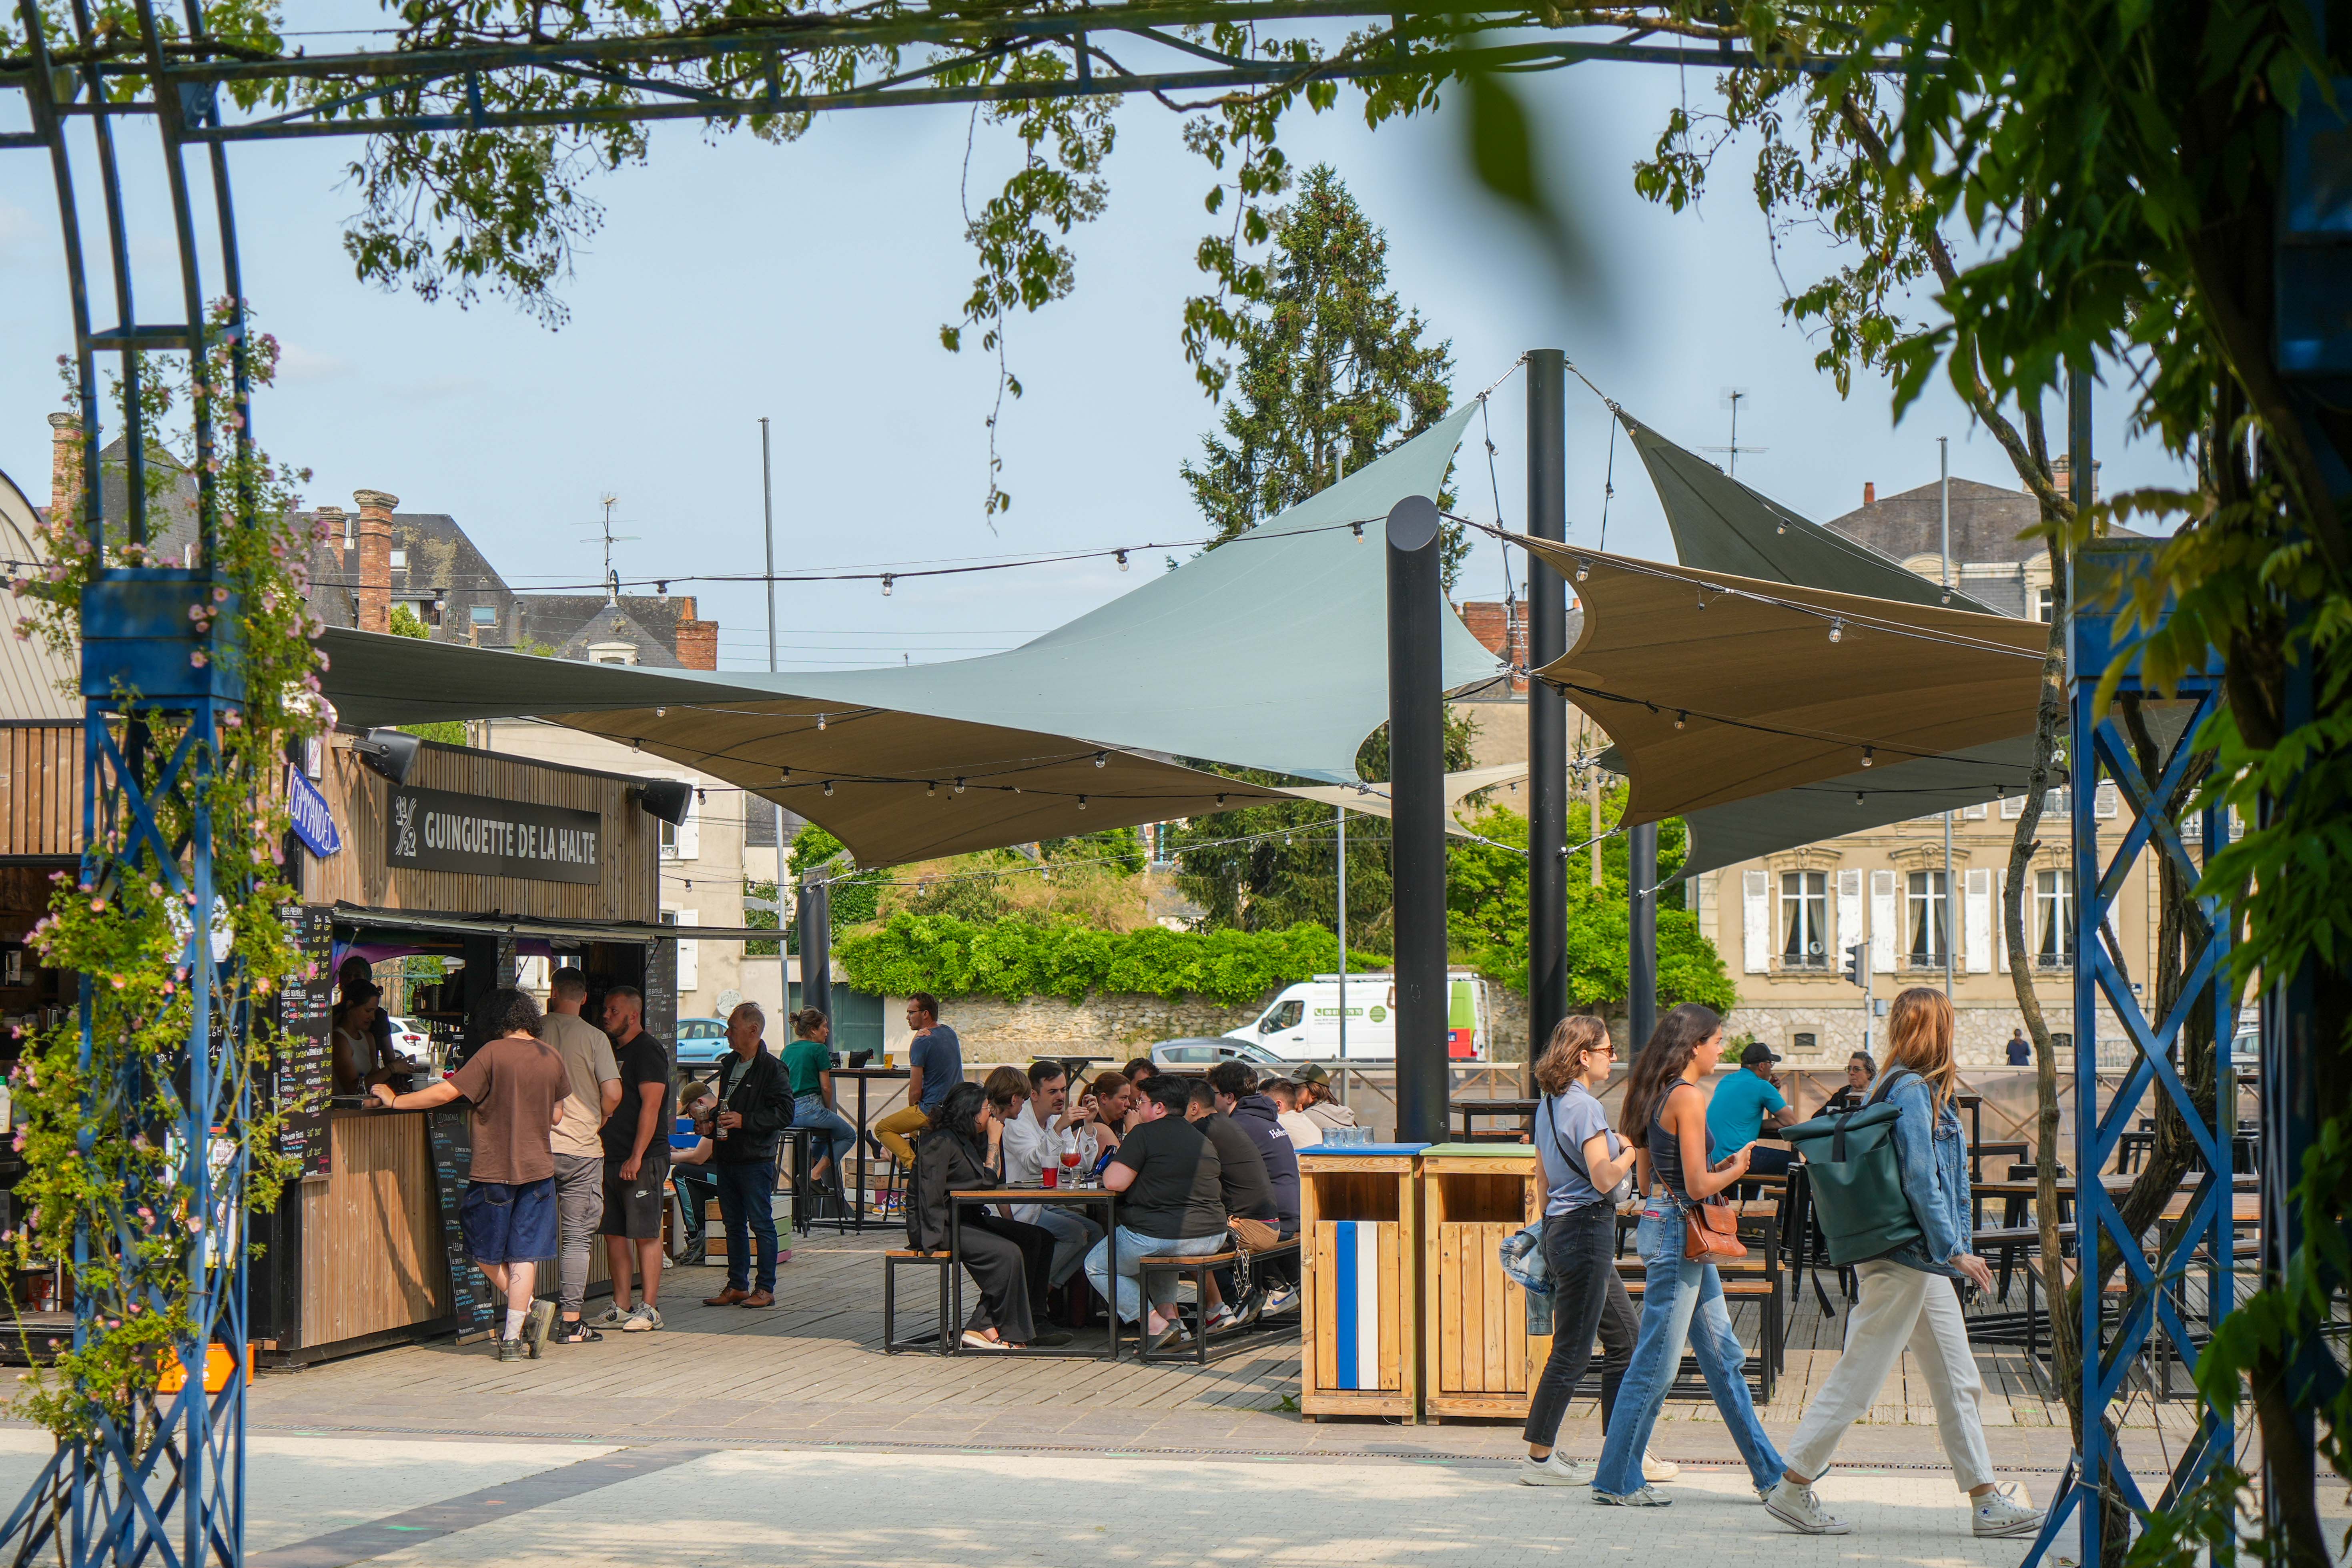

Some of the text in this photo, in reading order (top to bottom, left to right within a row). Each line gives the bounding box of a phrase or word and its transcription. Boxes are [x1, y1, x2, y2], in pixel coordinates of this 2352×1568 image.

[291, 776, 333, 851] COMMANDES
[425, 811, 596, 864] GUINGUETTE DE LA HALTE
[443, 1114, 459, 1122] COCKTAILS
